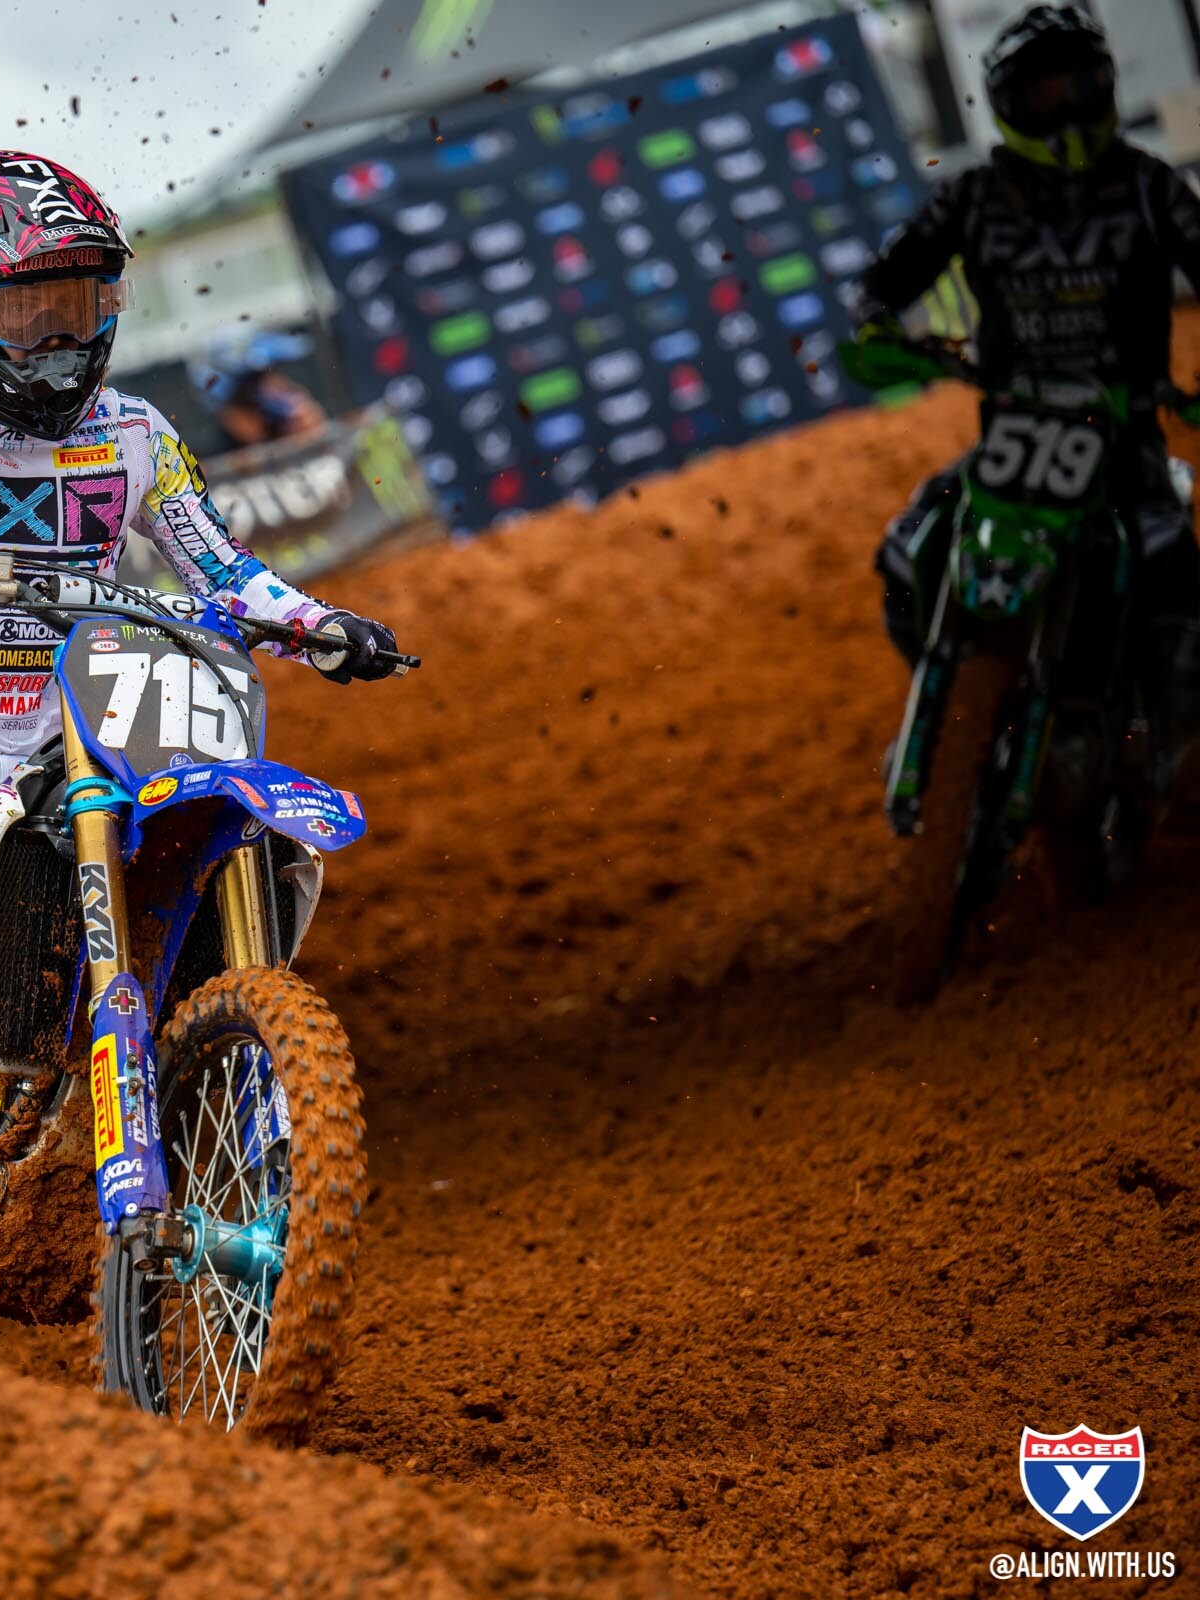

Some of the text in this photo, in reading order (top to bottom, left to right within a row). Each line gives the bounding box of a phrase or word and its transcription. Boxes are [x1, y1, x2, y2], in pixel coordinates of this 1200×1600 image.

[40, 223, 109, 241] Muc-Off
[58, 448, 108, 464] PIRELLI
[976, 414, 1104, 500] 519
[136, 626, 209, 646] MOTER
[88, 652, 249, 760] 715
[1, 718, 38, 731] SERVICES
[138, 779, 178, 801] FMF
[274, 807, 348, 824] CLUBMX
[78, 862, 117, 964] KYB
[92, 1047, 116, 1152] PIRELLI
[102, 1157, 145, 1188] SKDA
